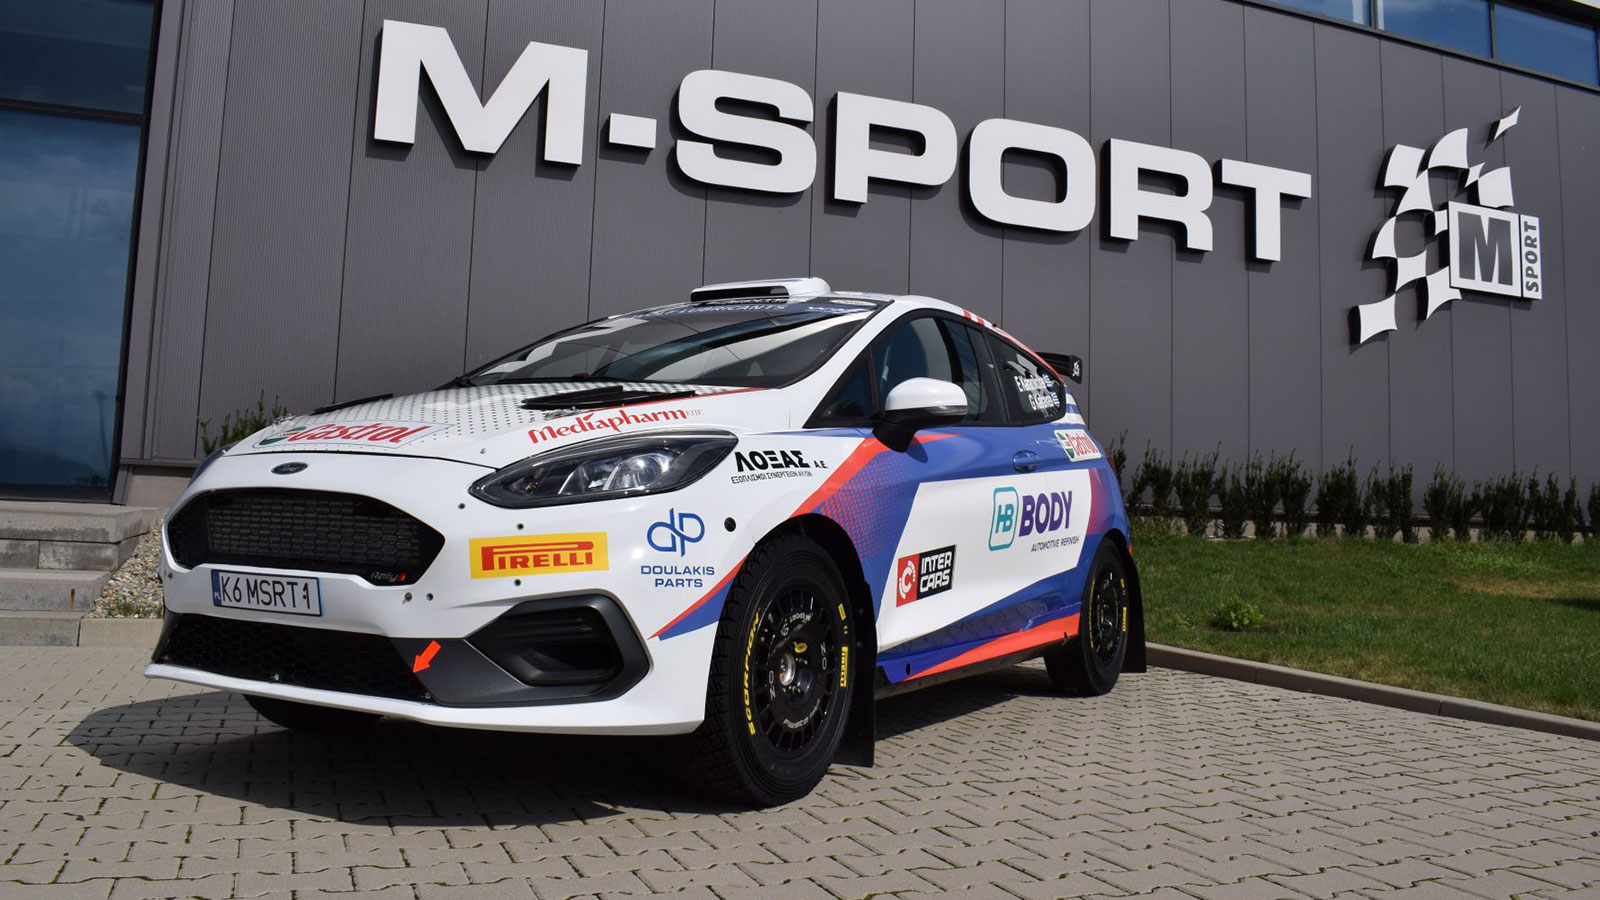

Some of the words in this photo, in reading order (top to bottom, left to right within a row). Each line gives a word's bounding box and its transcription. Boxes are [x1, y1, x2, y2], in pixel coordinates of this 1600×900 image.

[374, 19, 1312, 262] M-SPORT
[1457, 210, 1514, 287] M
[1524, 221, 1540, 293] SPORT
[287, 422, 434, 443] Castrol
[527, 409, 688, 444] Mediapharm
[734, 450, 811, 472] ΛΟΞΑΣ
[995, 503, 1015, 534] HB
[1018, 490, 1073, 537] BODY
[481, 541, 594, 571] PIRELLI
[641, 565, 715, 576] DOULAKIS
[921, 551, 952, 574] INTER
[221, 575, 242, 603] K6
[246, 578, 310, 610] MSRT1
[655, 578, 703, 588] PARTS
[919, 569, 951, 593] CARS
[743, 610, 761, 736] SCORPION
